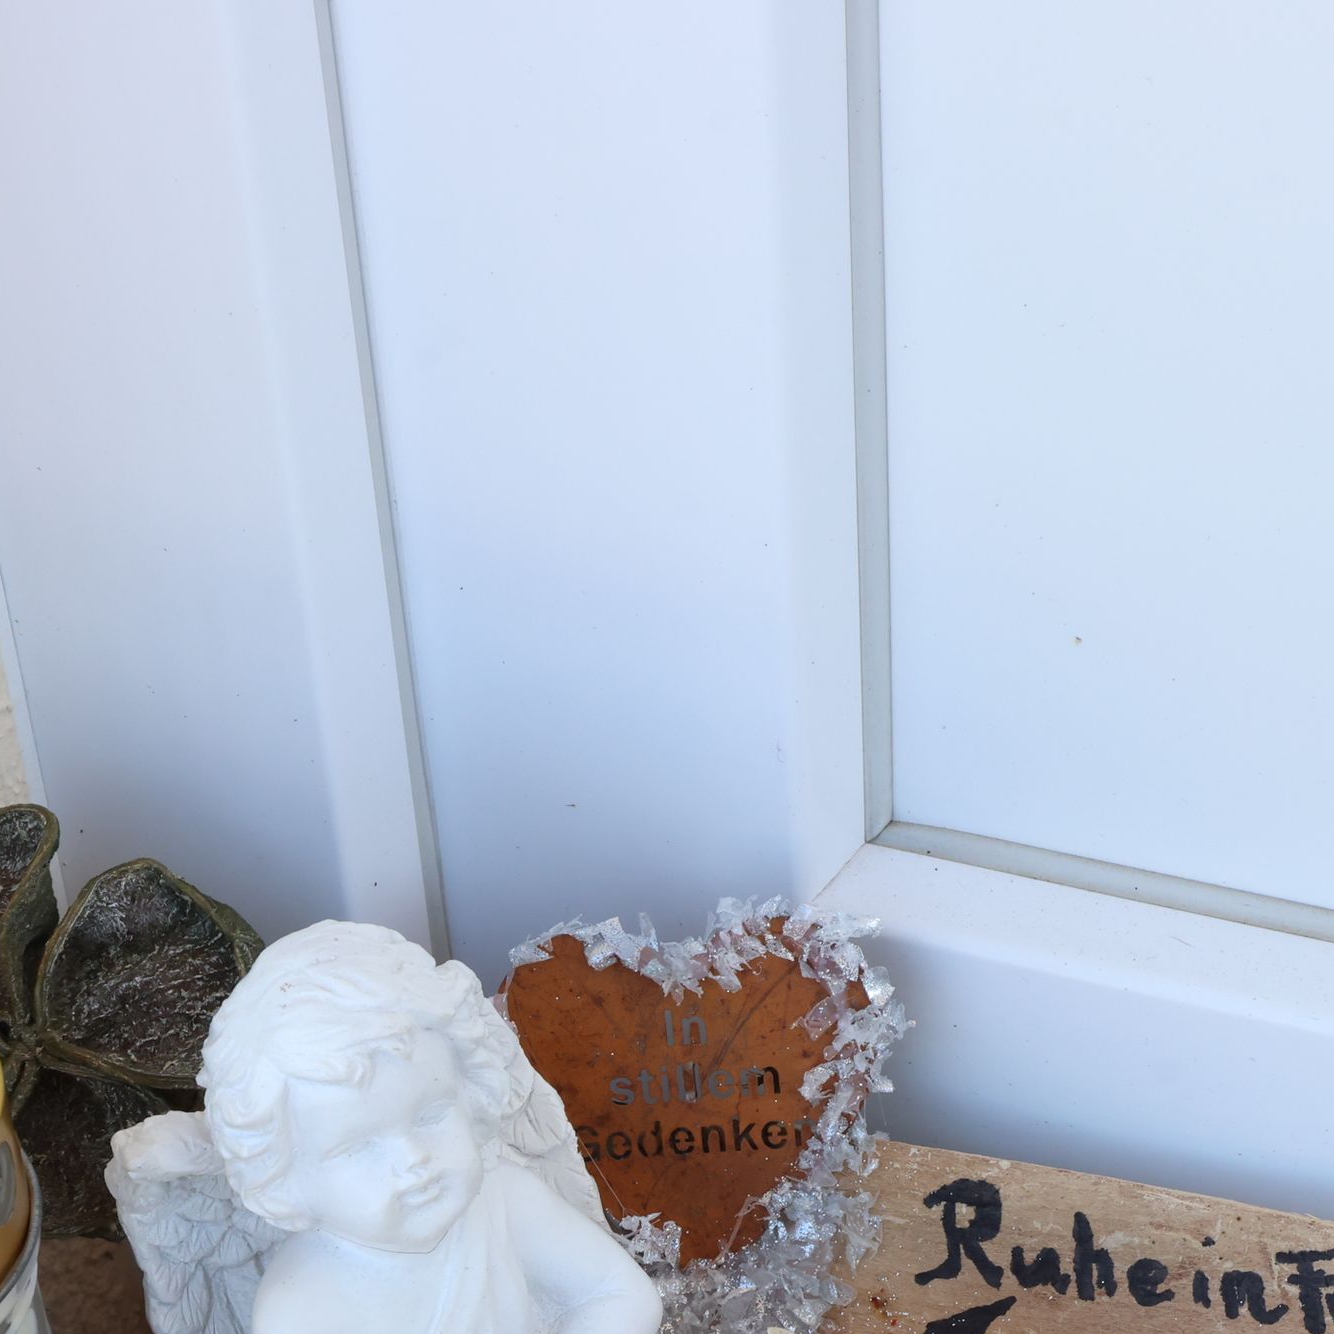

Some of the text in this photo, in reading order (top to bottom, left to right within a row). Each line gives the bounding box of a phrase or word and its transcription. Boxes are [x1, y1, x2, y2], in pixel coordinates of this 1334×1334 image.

[664, 1010, 708, 1047] In
[610, 1062, 781, 1105] stillem
[914, 1178, 1175, 1307] Ruhe
[1192, 1236, 1290, 1325] in
